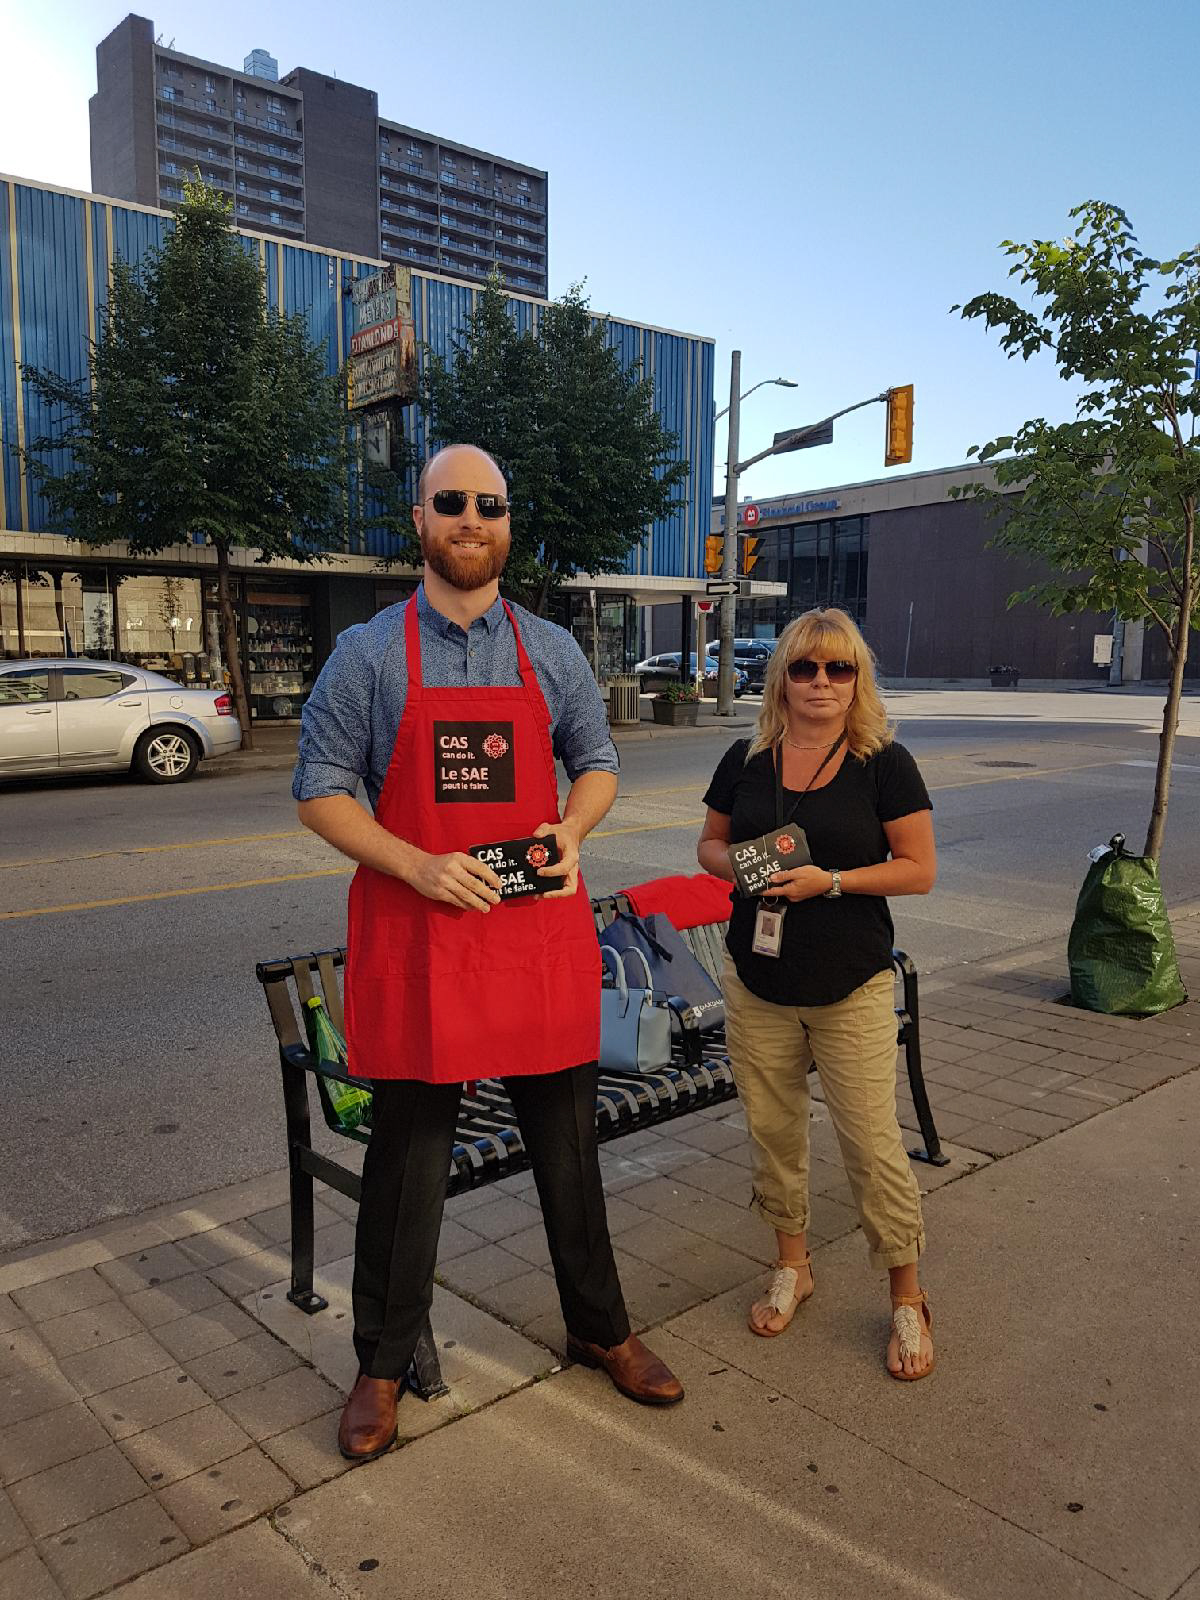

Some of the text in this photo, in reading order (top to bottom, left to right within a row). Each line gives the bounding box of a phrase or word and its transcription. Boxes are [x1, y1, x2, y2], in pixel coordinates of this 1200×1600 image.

[360, 293, 391, 326] MEYERS
[439, 735, 469, 749] CAS
[456, 751, 467, 759] do
[441, 766, 489, 780] Le SAE
[461, 782, 468, 790] le
[469, 782, 490, 790] faire.
[477, 847, 504, 862] CAS
[735, 845, 757, 862] CAS
[495, 860, 507, 869] do
[508, 859, 518, 867] it.
[739, 860, 752, 869] can
[752, 855, 763, 864] do
[500, 870, 526, 886] SAE
[744, 860, 781, 884] Le SAE
[513, 883, 537, 893] faire.
[748, 880, 765, 893] peut
